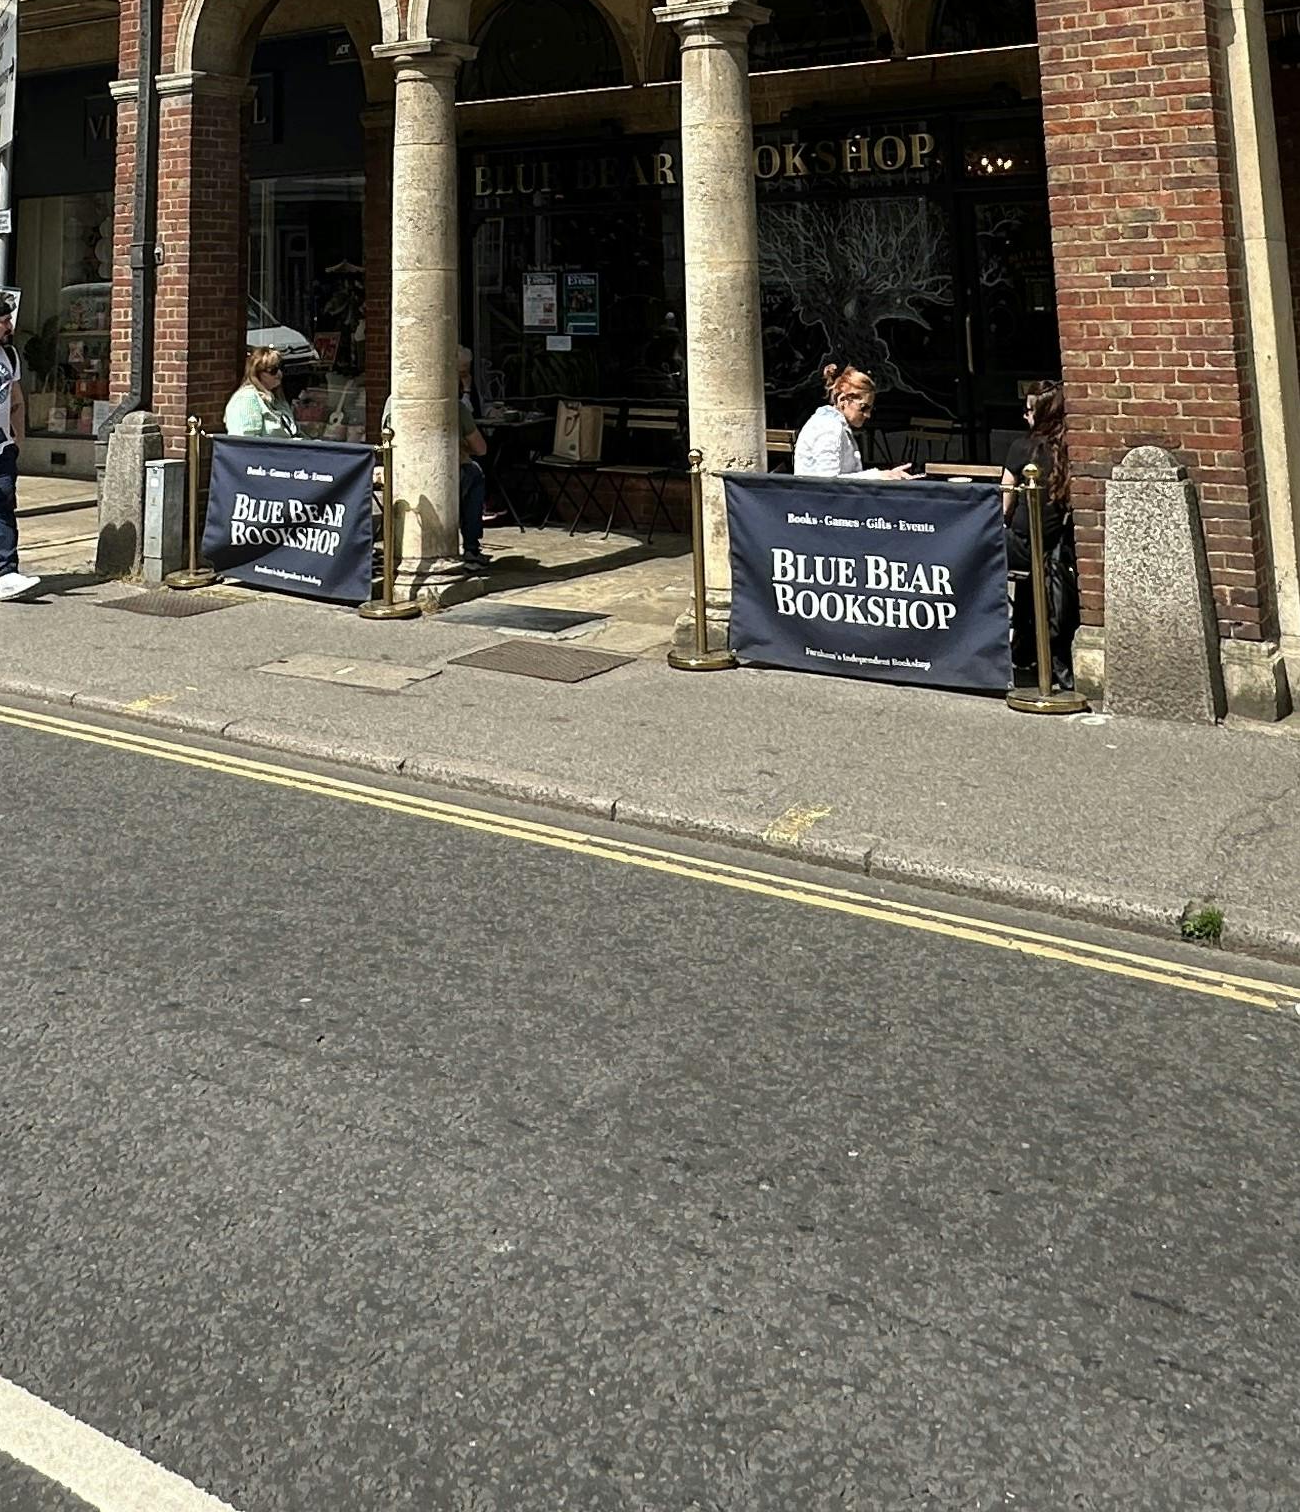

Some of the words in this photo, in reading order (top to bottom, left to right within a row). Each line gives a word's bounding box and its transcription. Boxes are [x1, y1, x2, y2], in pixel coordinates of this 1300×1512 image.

[754, 133, 935, 179] OKSHOP
[788, 513, 818, 525] Books
[824, 515, 860, 528] Games
[866, 518, 892, 531] Gifts
[899, 520, 935, 533] Events
